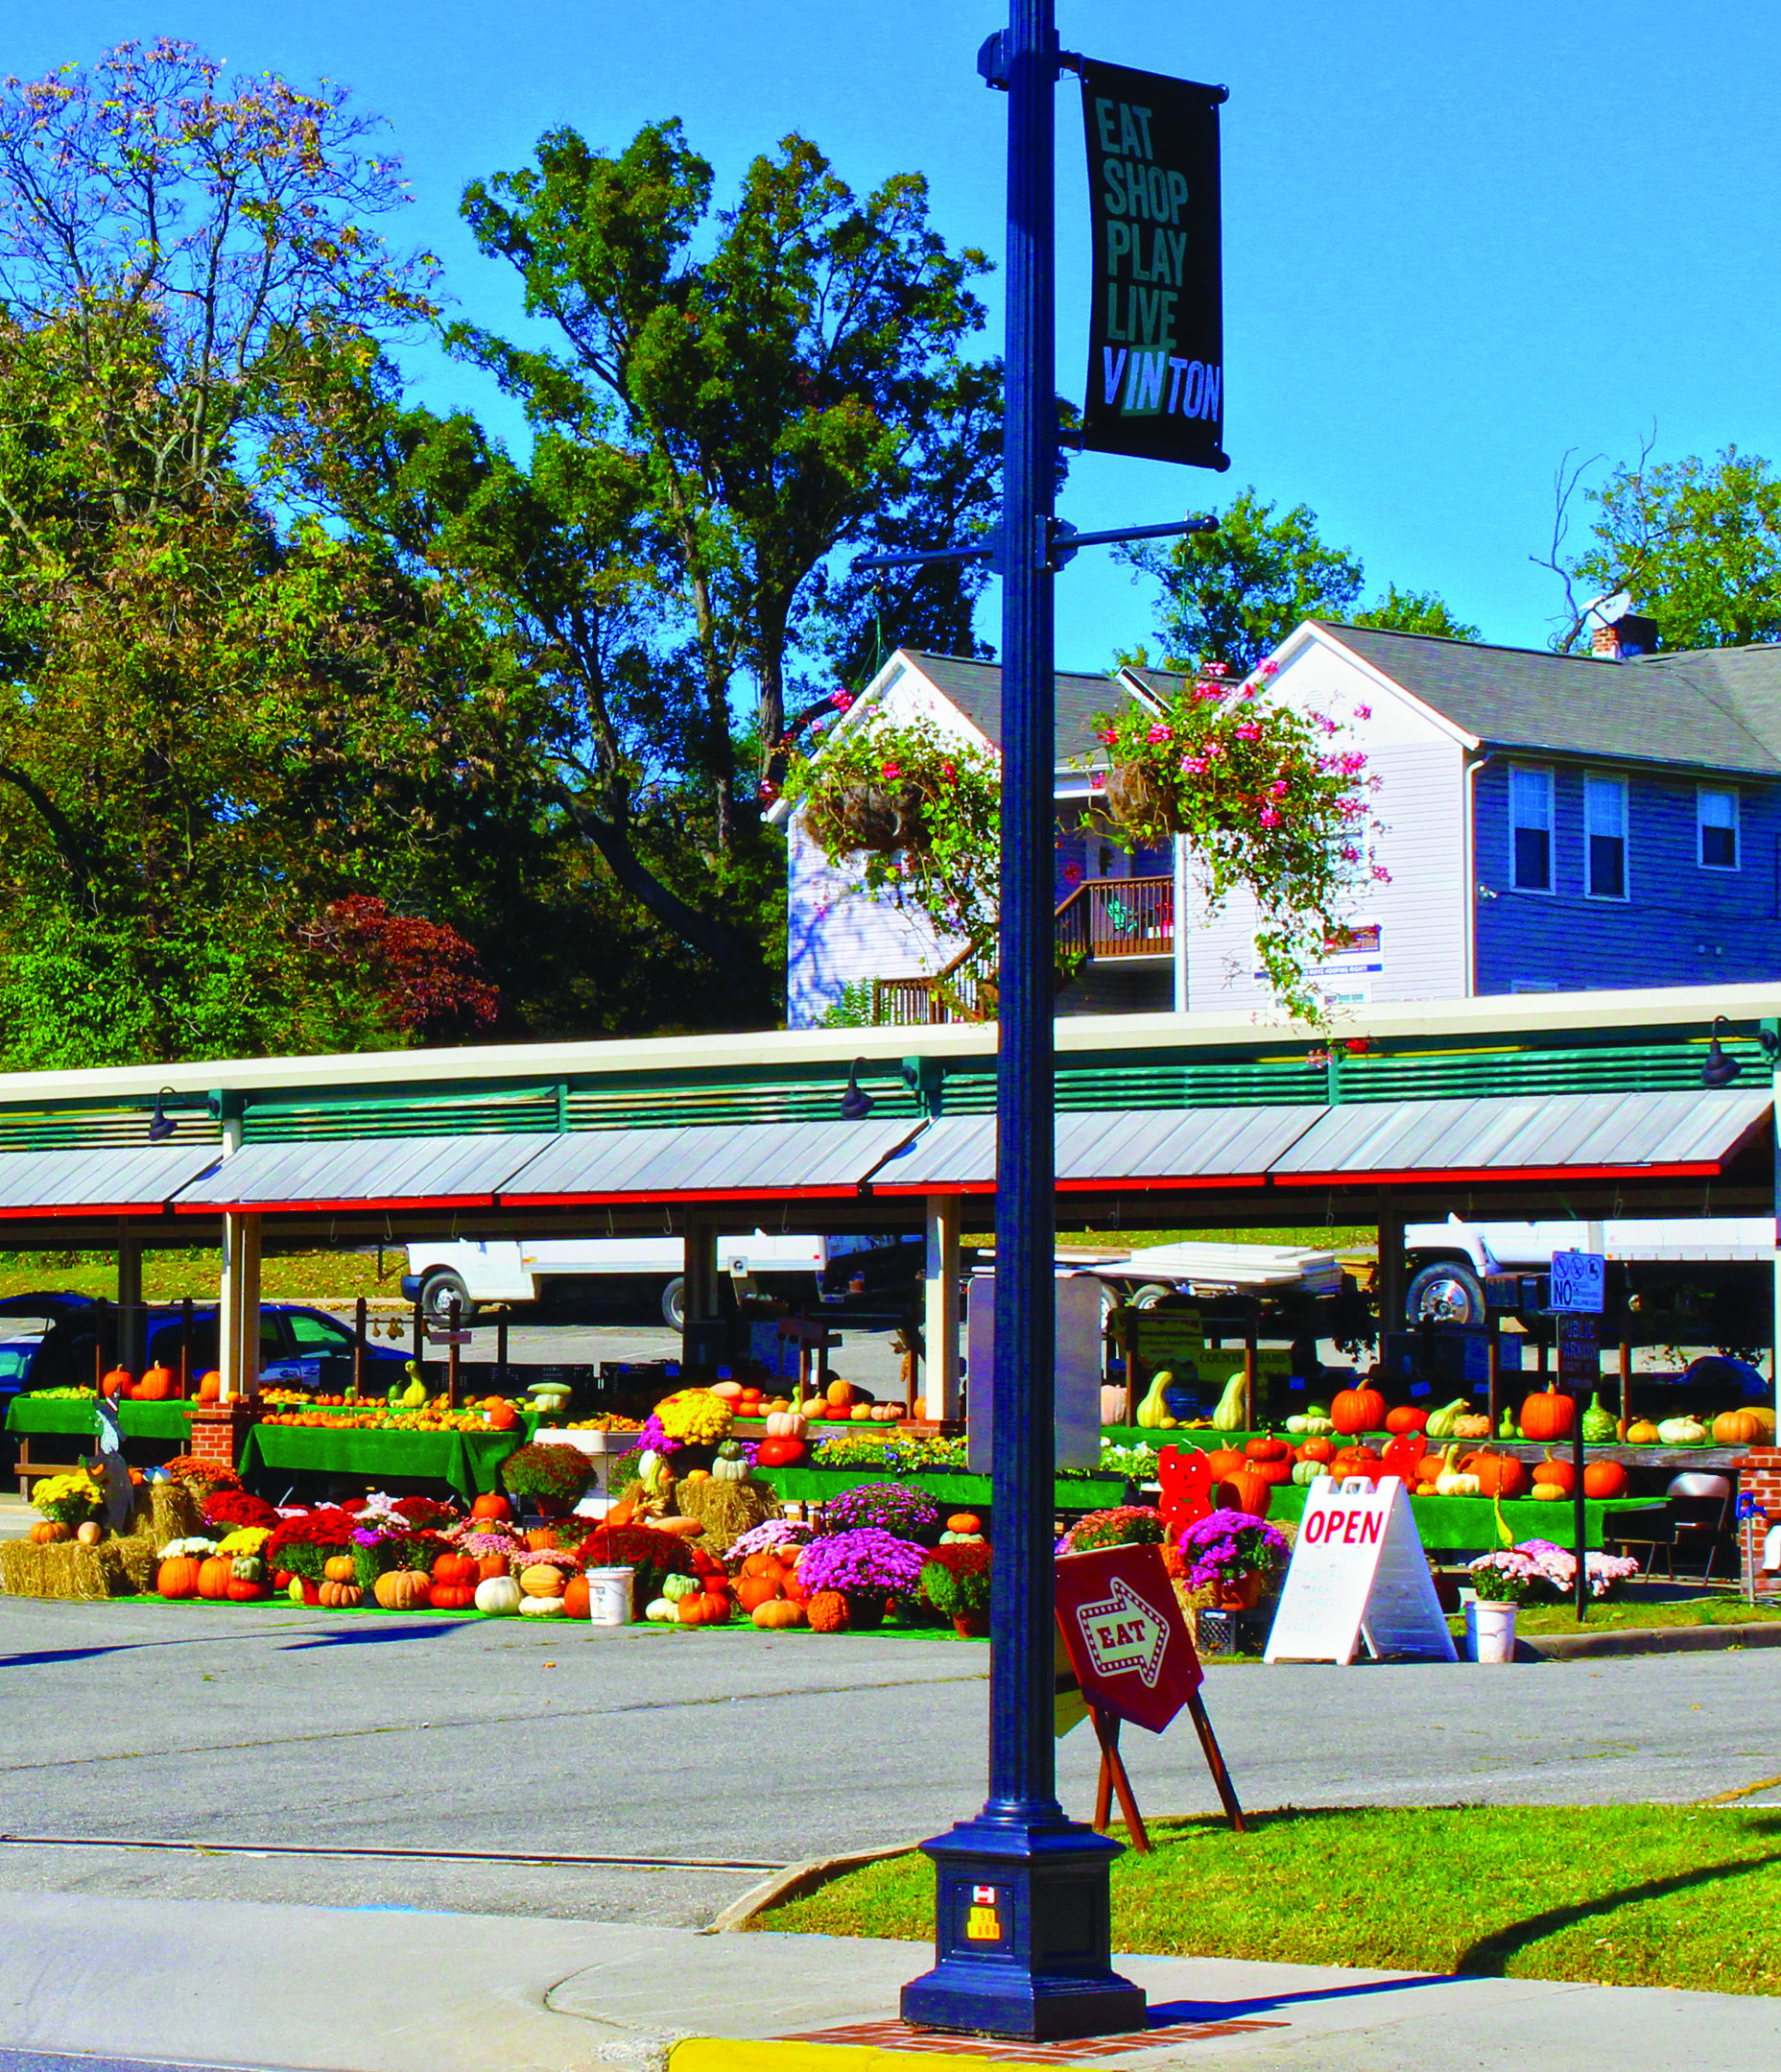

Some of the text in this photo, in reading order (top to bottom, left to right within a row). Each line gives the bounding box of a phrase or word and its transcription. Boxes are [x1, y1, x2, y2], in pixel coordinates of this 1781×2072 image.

[1095, 97, 1154, 160] EAT
[1103, 157, 1189, 226] SHOP
[1106, 220, 1188, 287] PLAY
[1106, 282, 1178, 348] LIVE
[1103, 345, 1221, 422] VINTON
[1555, 1279, 1573, 1306] NO
[1558, 1340, 1600, 1361] PARKING
[1560, 1319, 1596, 1339] PUBLIC
[1305, 1511, 1384, 1544] OPEN
[1096, 1619, 1147, 1650] EAT
